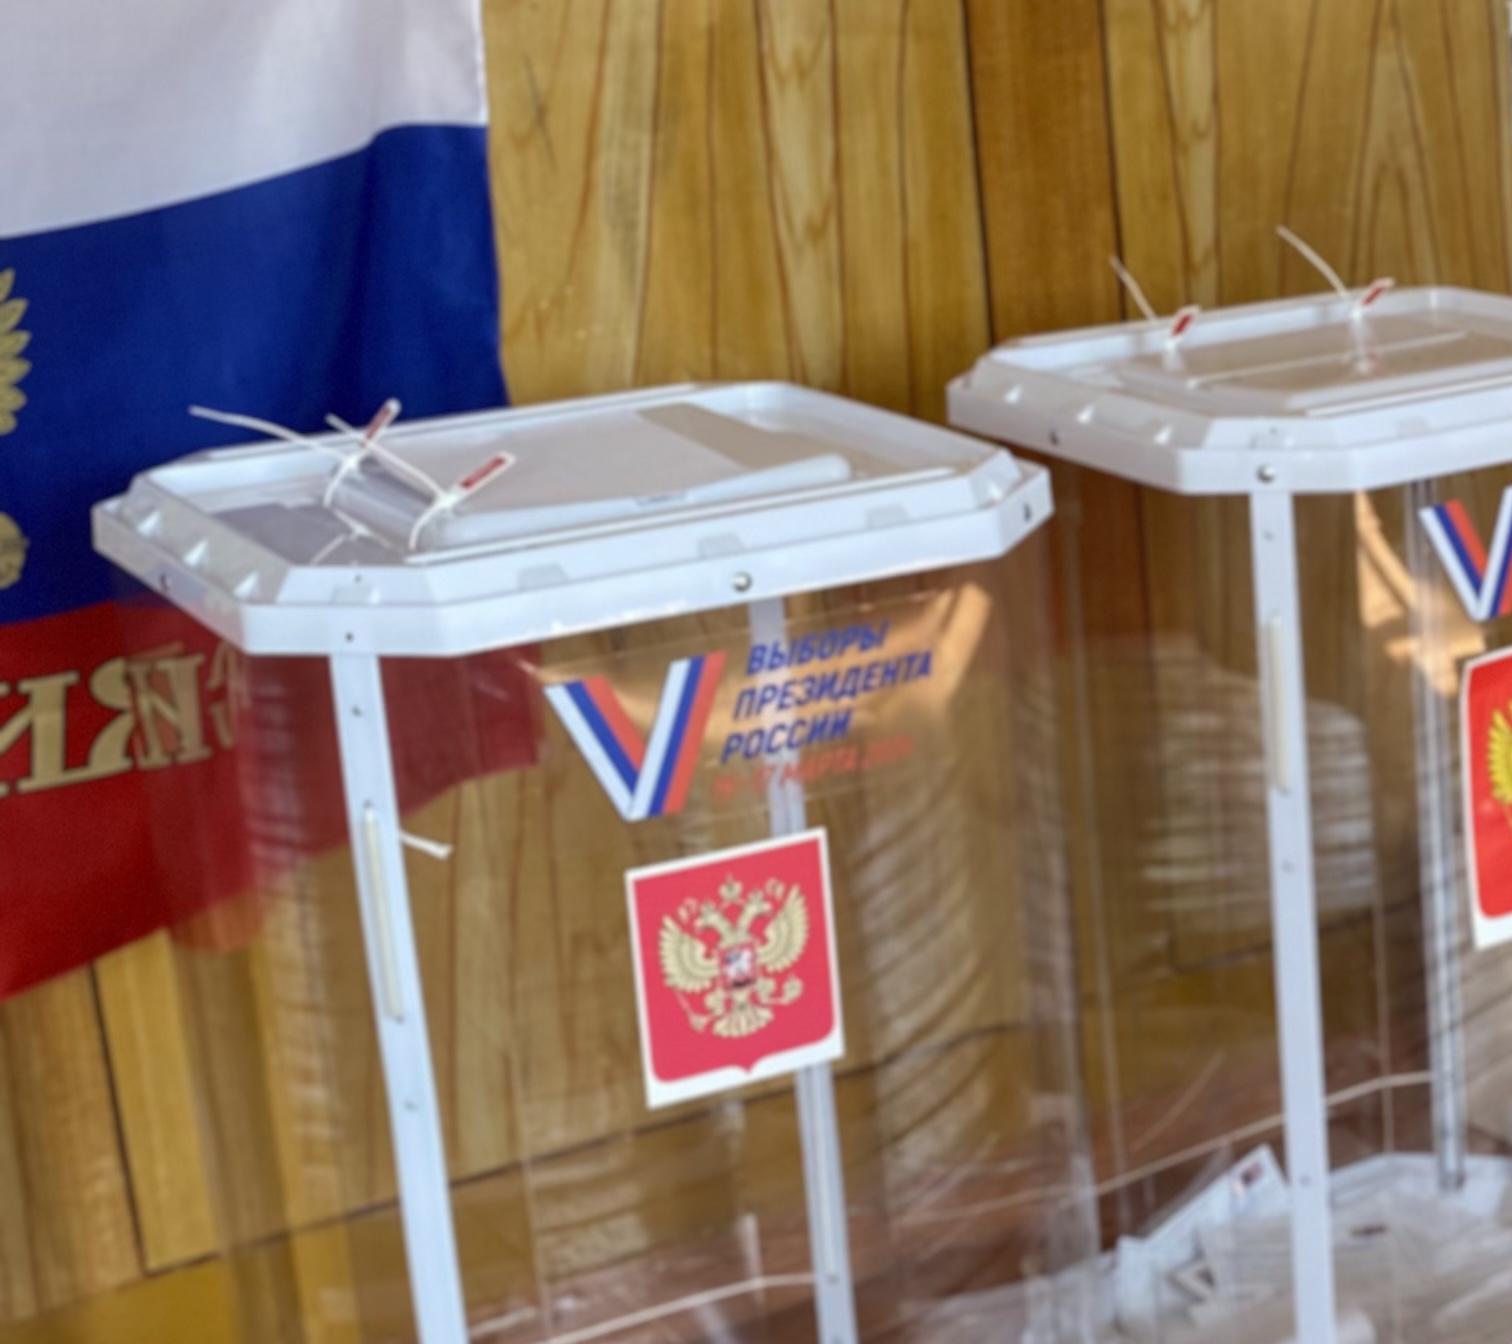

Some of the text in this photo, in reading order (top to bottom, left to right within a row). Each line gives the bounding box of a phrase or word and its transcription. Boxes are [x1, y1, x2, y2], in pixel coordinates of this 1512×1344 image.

[746, 618, 891, 676] ВЫБОРЫ
[733, 649, 932, 723] ПРЕЗИДЕНТА
[720, 706, 852, 766] РОССИИ
